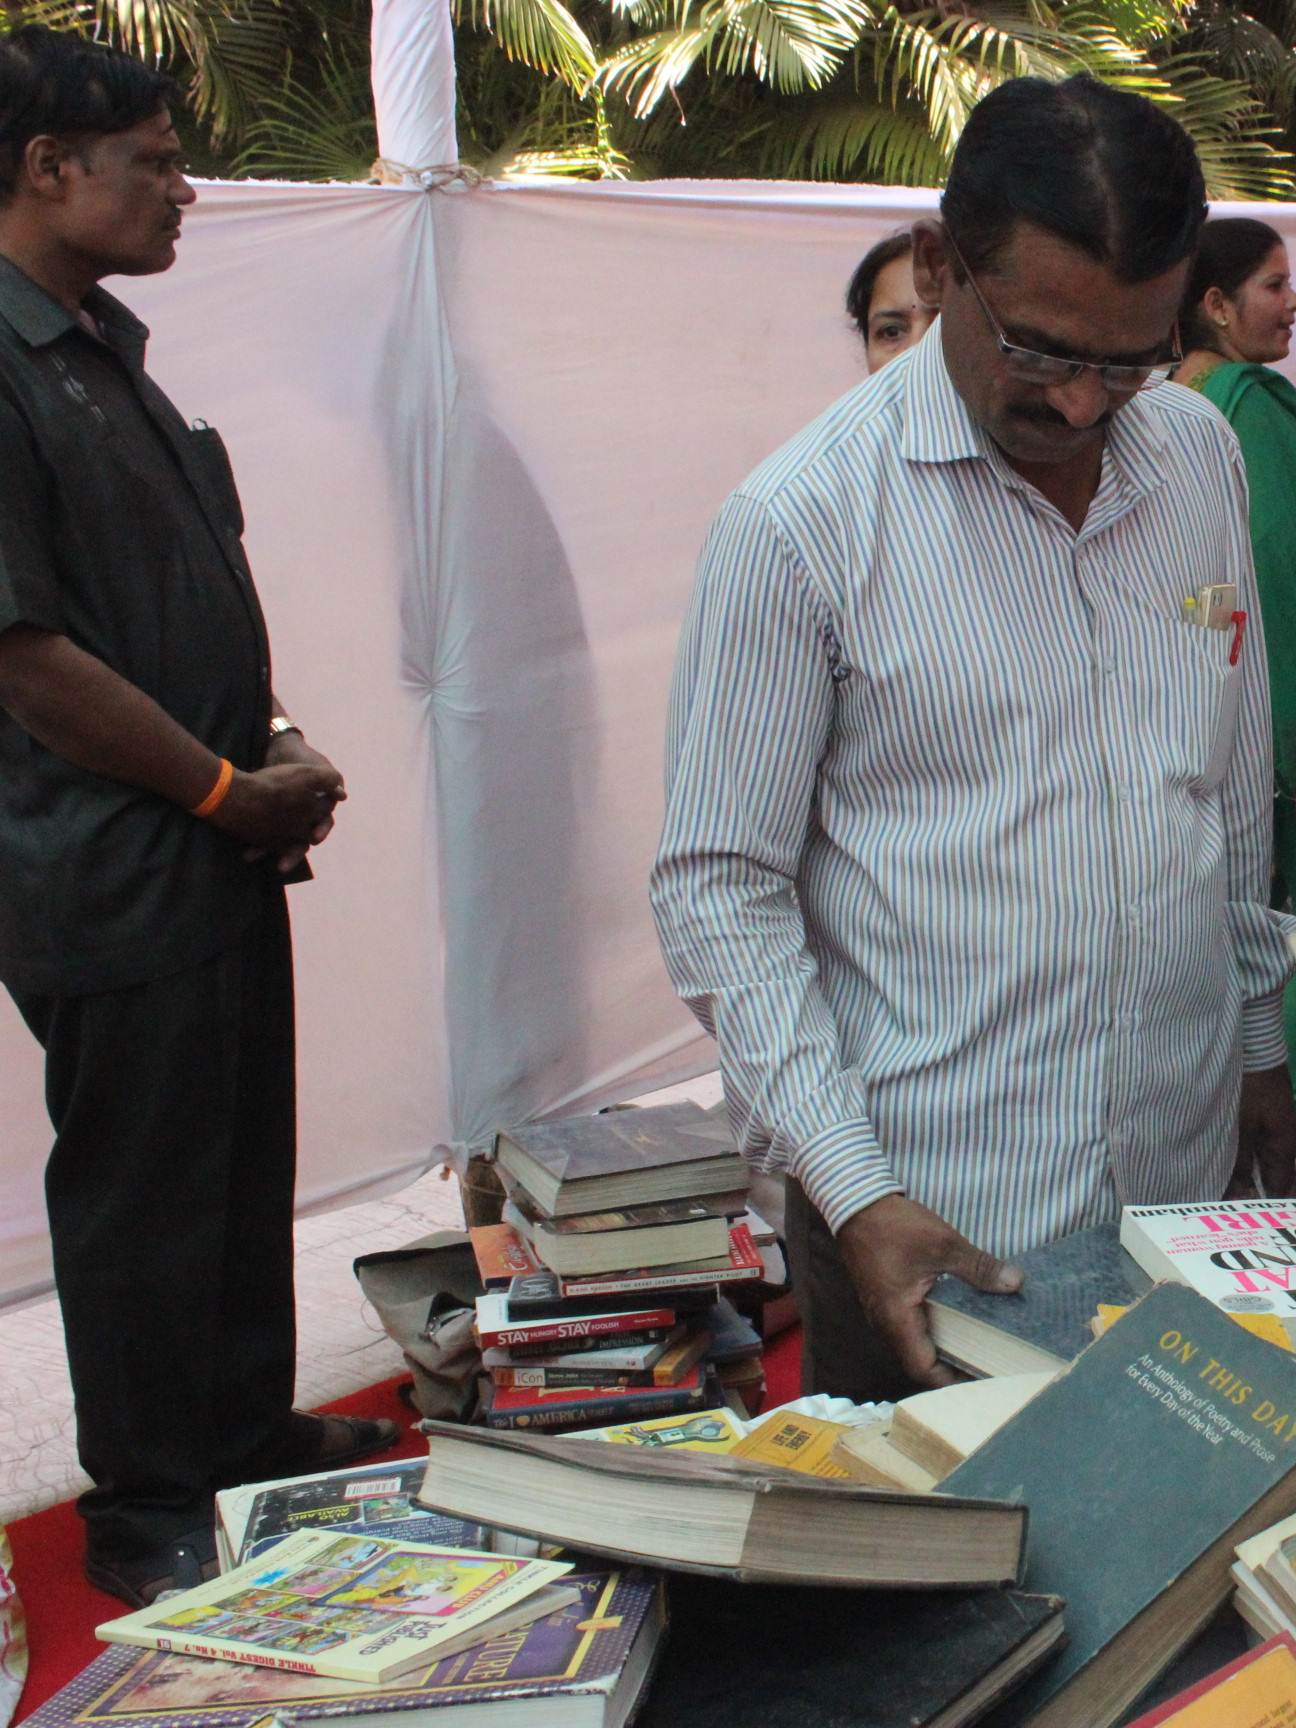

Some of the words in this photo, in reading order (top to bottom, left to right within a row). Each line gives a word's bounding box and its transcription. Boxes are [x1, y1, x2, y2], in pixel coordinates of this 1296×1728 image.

[1130, 1203, 1236, 1219] Dunham
[1166, 1245, 1217, 1255] woman
[497, 1331, 530, 1346] STAY
[530, 1328, 557, 1338] HUNGRY
[558, 1321, 591, 1338] STAY
[591, 1320, 619, 1331] FOOLISH
[1159, 1330, 1198, 1364] ON
[1199, 1358, 1253, 1404] THIS
[517, 1371, 544, 1384] iCon
[1124, 1363, 1140, 1380] for
[1137, 1373, 1162, 1400] Every
[1159, 1390, 1181, 1414] Day
[1176, 1405, 1192, 1422] of
[1187, 1413, 1205, 1430] the
[1201, 1426, 1224, 1446] Year
[1137, 1353, 1155, 1370] An
[1150, 1361, 1198, 1404] Anthology
[1202, 1403, 1239, 1436] Poetry
[1229, 1425, 1252, 1444] and
[1249, 1438, 1276, 1463] Prose
[531, 1409, 587, 1427] AMERICA
[217, 1648, 239, 1662] Vol.
[239, 1652, 278, 1667] DIGEST
[463, 1622, 534, 1683] ATURE
[279, 1658, 317, 1673] TINKLE
